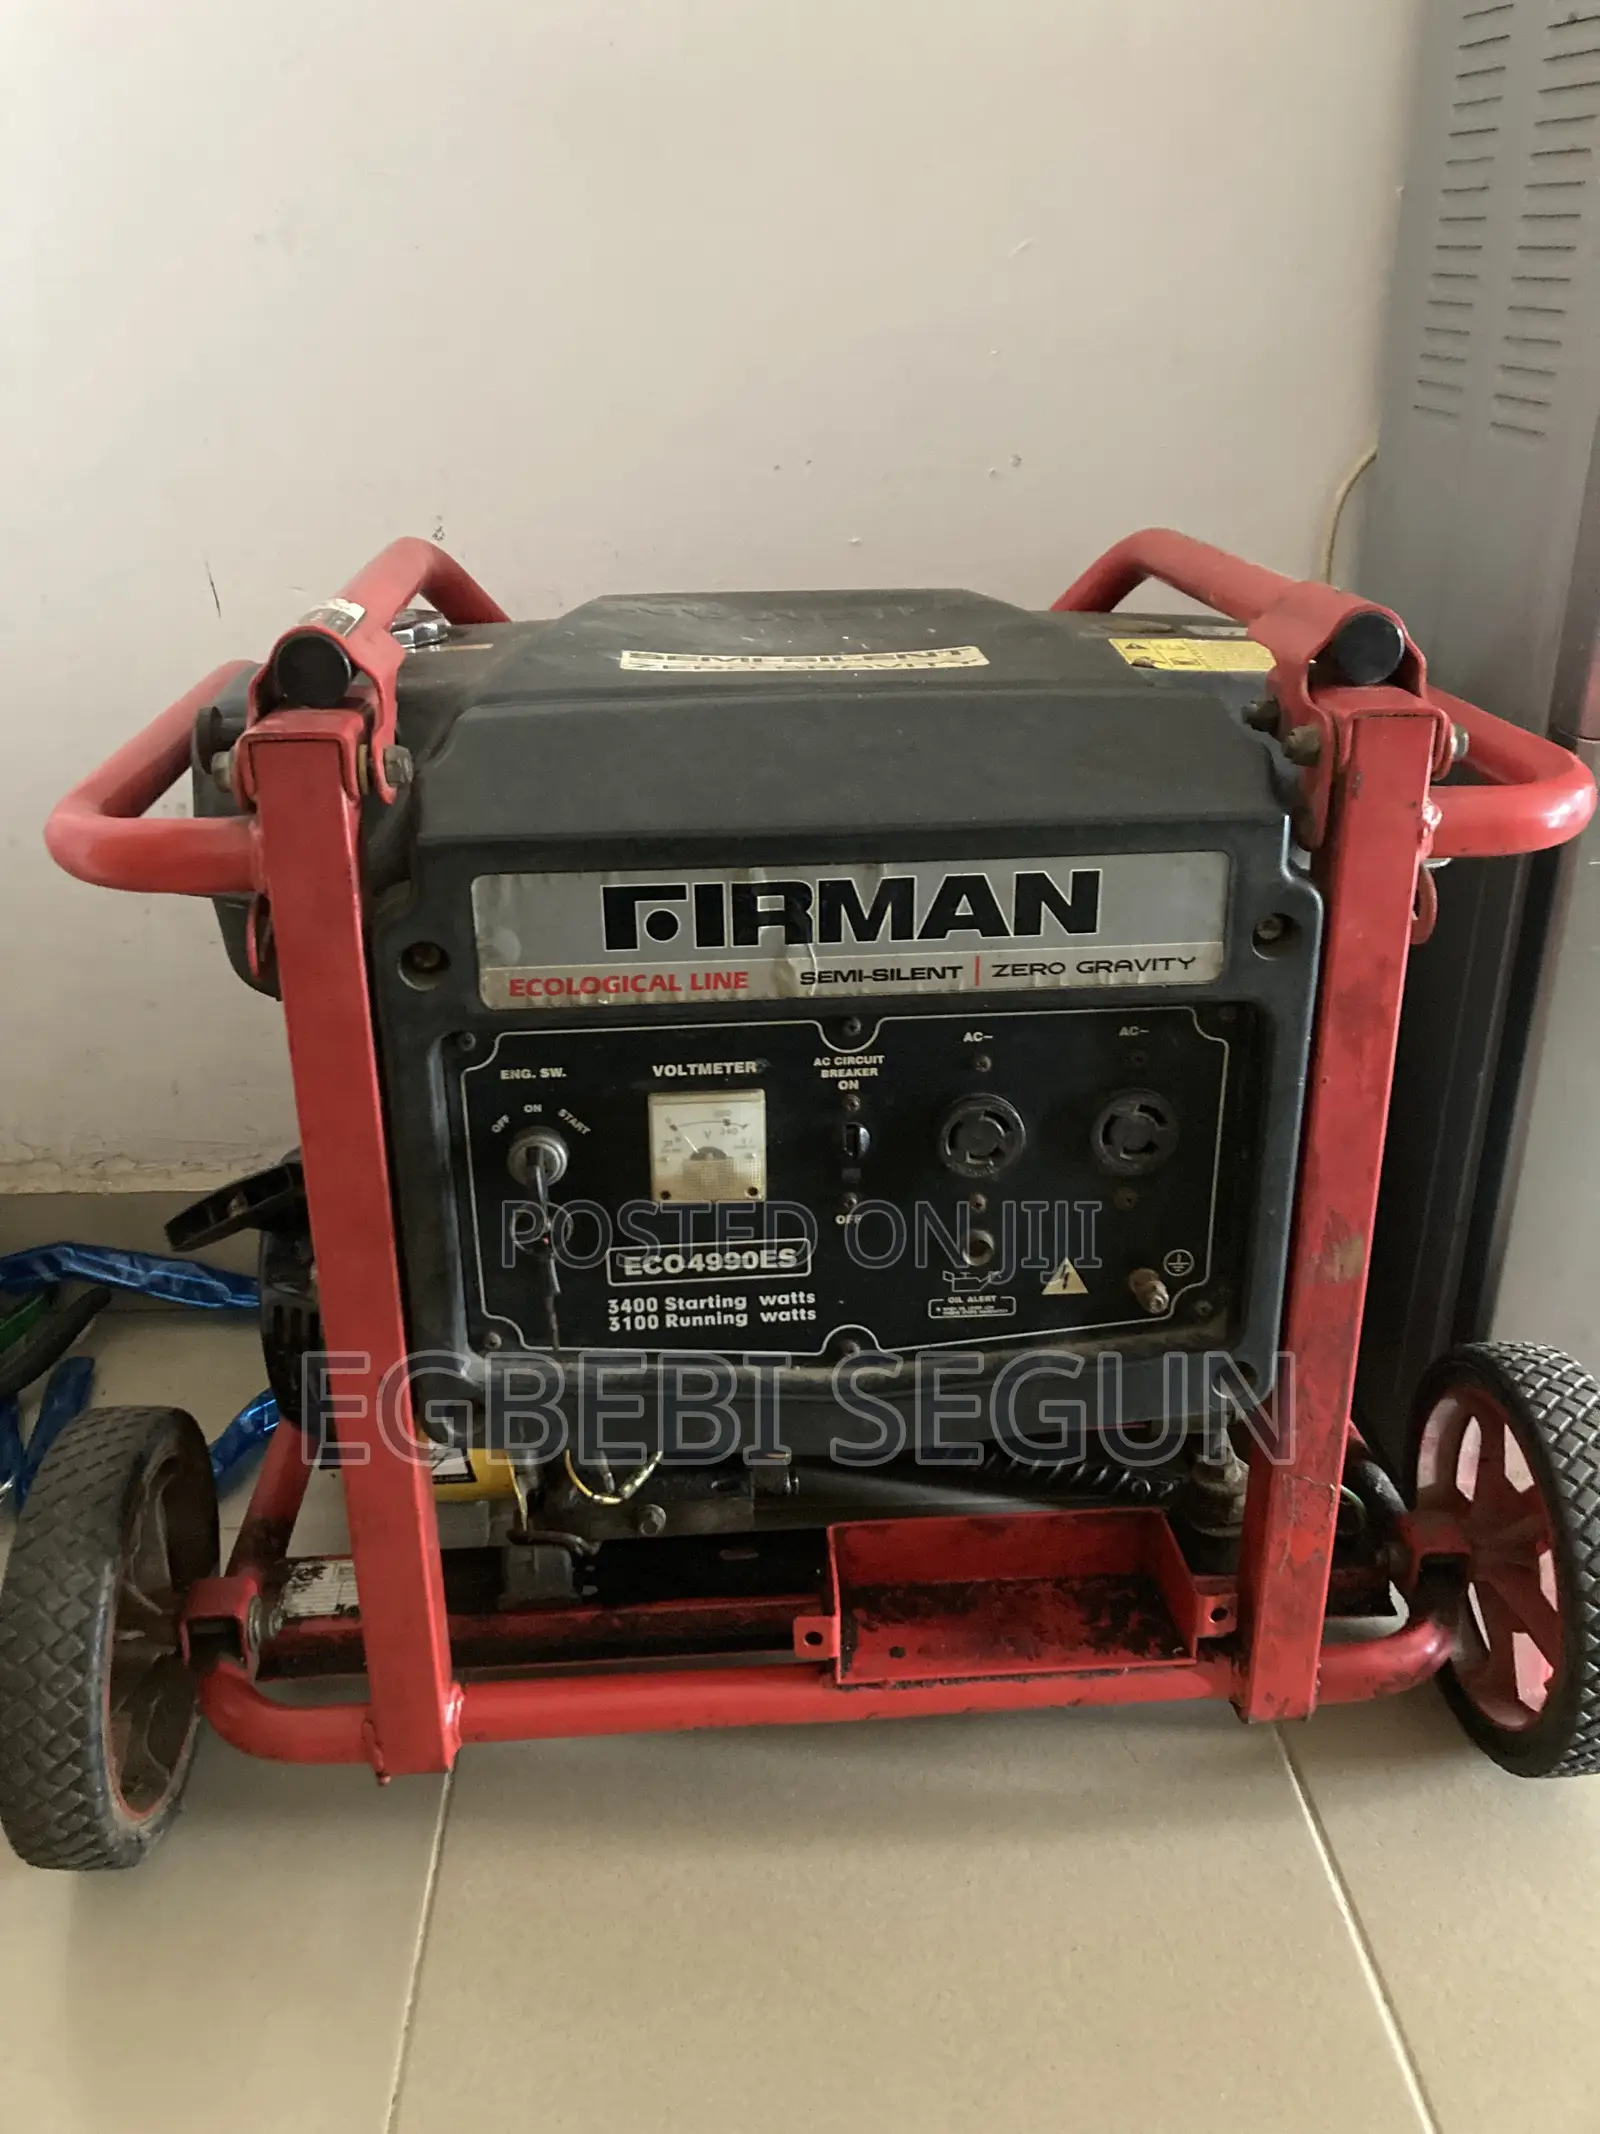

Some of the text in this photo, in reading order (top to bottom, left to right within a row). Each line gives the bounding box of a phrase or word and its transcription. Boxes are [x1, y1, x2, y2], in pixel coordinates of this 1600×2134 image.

[601, 868, 1103, 952] FIRMAN
[799, 965, 963, 986] SEMI-SILENT
[991, 956, 1198, 979] ZERO GRAVITY
[509, 971, 749, 997] ECOLOGICAL LINE
[652, 1061, 757, 1077] VOLTMETER
[813, 1055, 885, 1067] AC CIRCUIT
[500, 1067, 567, 1080] ENG. SW.
[821, 1067, 879, 1079] BREAKER
[837, 1079, 859, 1091] ON
[523, 1104, 543, 1113] ON
[491, 1114, 510, 1133] OFF
[558, 1108, 591, 1135] START
[835, 1213, 862, 1225] OFF
[624, 1248, 798, 1276] ECO4990ES
[607, 1291, 816, 1315] 3400 Starting watts
[967, 1295, 998, 1303] ALERT
[608, 1308, 817, 1332] 3100 Running watts
